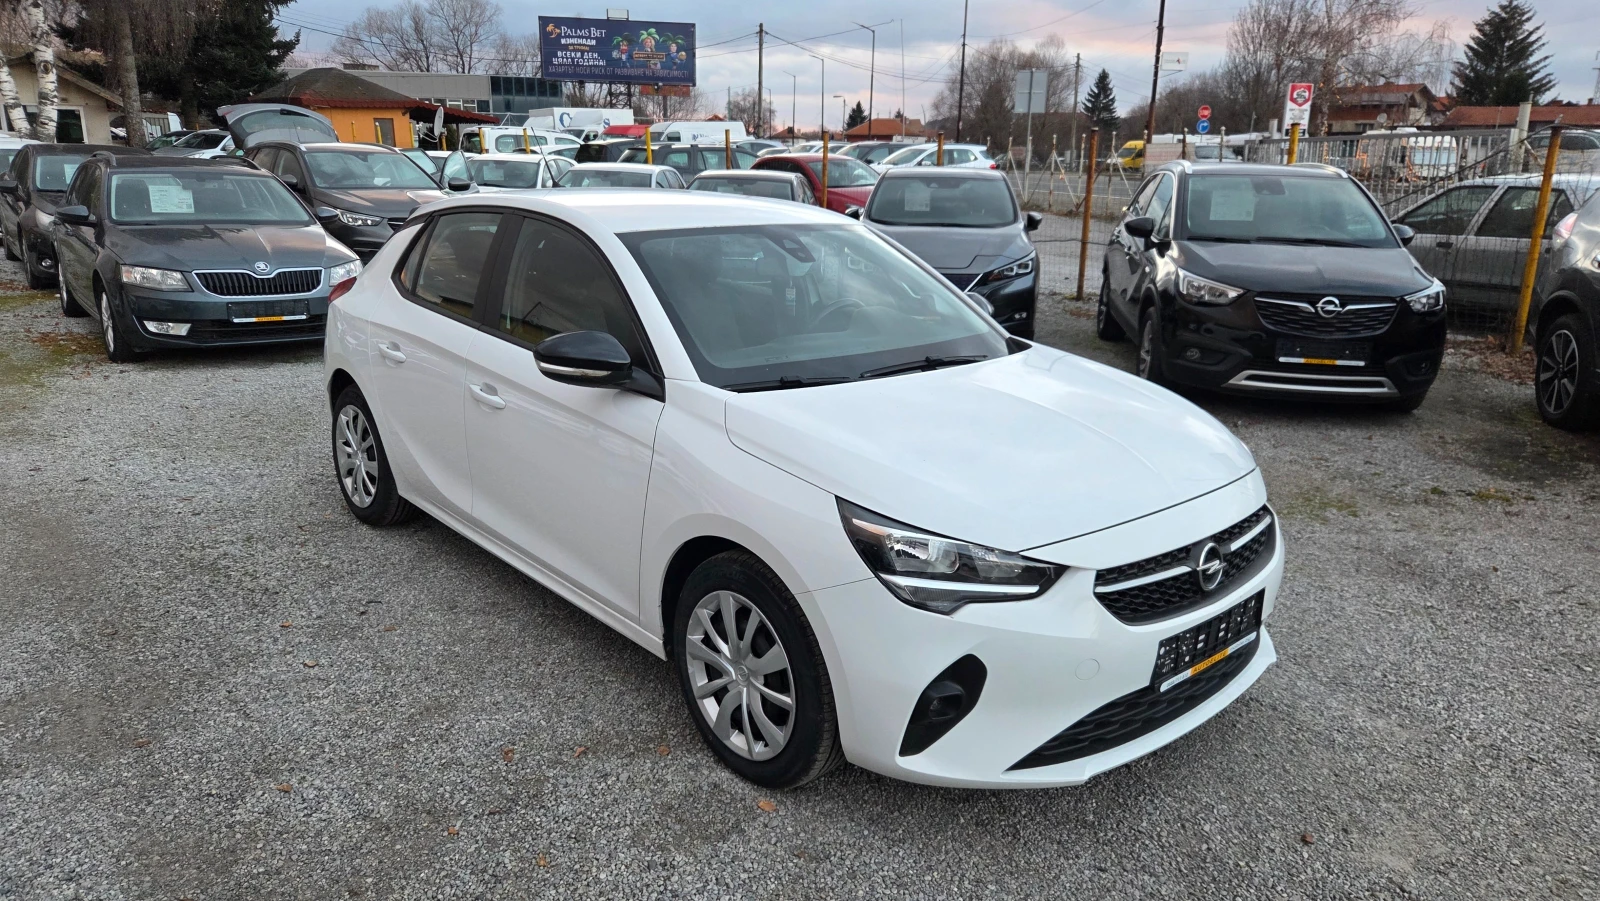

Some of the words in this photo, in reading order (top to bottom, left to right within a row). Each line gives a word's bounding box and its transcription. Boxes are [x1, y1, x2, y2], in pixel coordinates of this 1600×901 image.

[561, 26, 589, 36] PALMS
[591, 27, 606, 37] BET
[561, 37, 596, 45] ИЗНЕНАДИ
[574, 58, 606, 66] ГОДИНА!
[548, 66, 574, 74] ХАЗАРТЪТ
[591, 67, 605, 75] РИСК
[606, 67, 613, 75] ОТ
[1193, 650, 1228, 674] AUTOELITE
